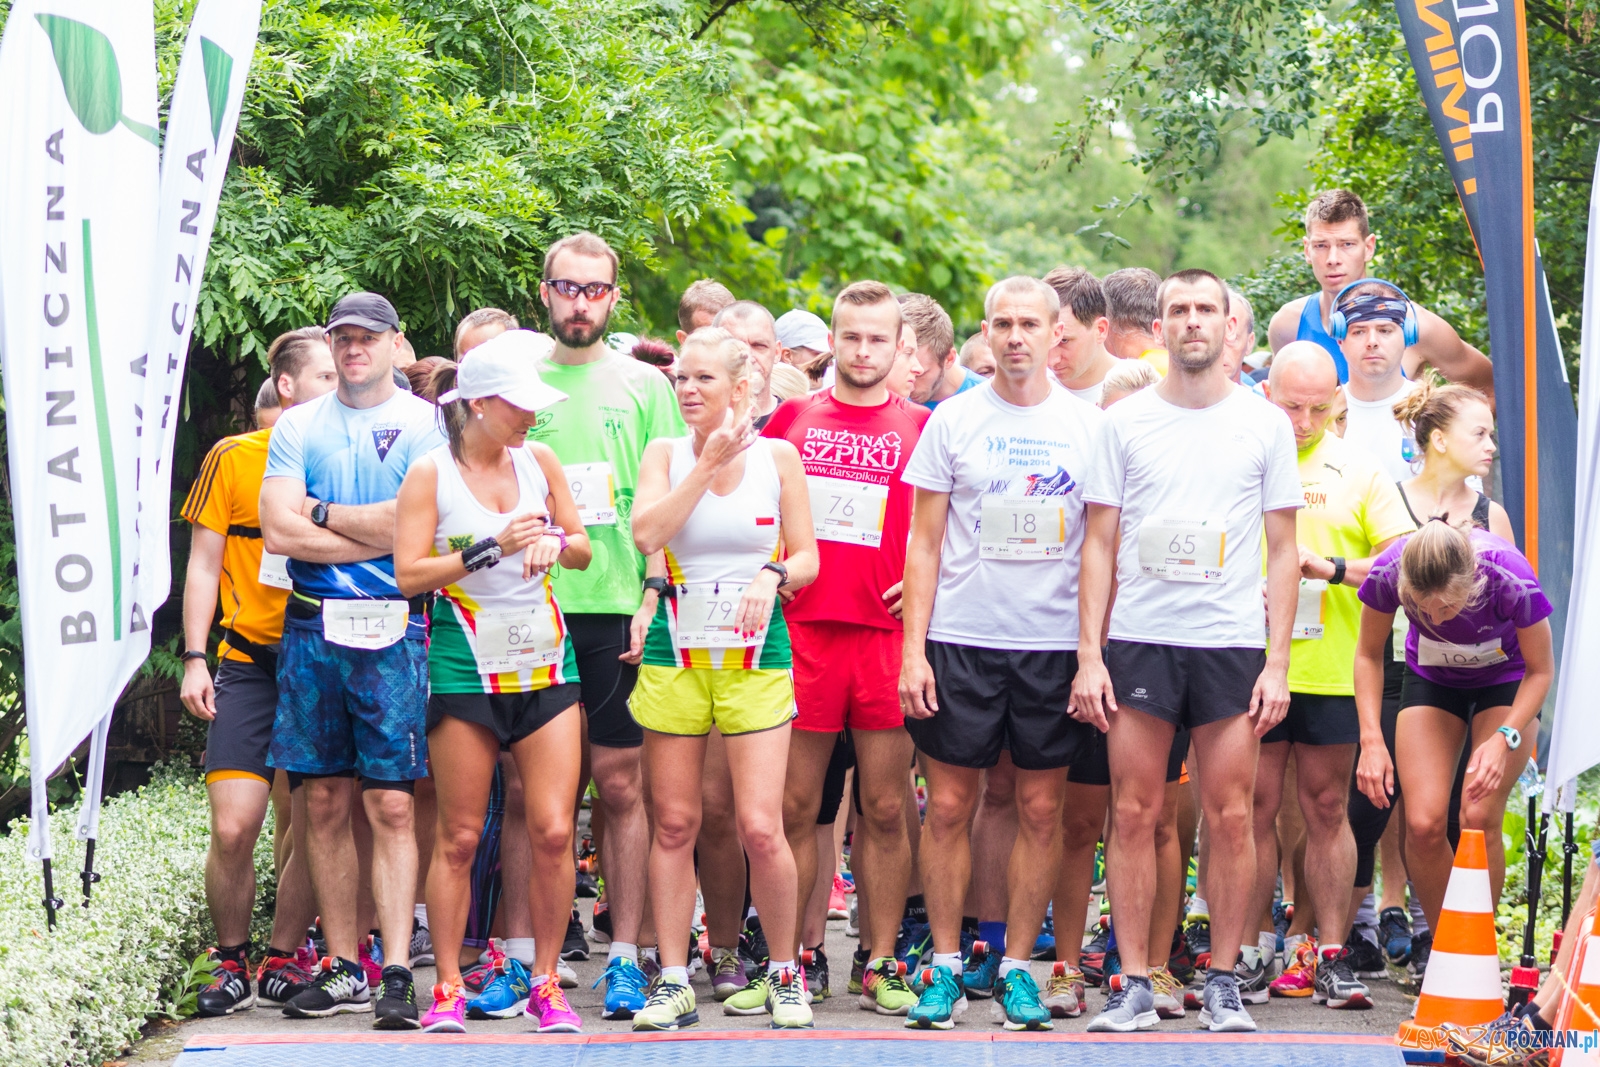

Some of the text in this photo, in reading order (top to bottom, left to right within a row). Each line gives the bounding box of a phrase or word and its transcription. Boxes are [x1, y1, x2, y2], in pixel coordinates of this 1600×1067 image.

[43, 128, 97, 645] BOTANICZNA
[805, 427, 885, 449] DRUŻYNA
[1009, 437, 1070, 449] Półmaraton
[802, 441, 901, 470] SZPIKU
[1008, 458, 1051, 467] Piła 2014
[1009, 448, 1050, 457] PHILIPS
[804, 464, 890, 485] www.darszpiku.pl
[988, 480, 1011, 493] MIX
[829, 495, 855, 517] 76
[1304, 492, 1327, 504] RUN
[1012, 513, 1036, 534] 18
[1168, 533, 1196, 555] 65
[706, 601, 733, 621] 79
[349, 616, 386, 631] 114
[507, 624, 534, 645] 82
[1441, 652, 1480, 664] 104
